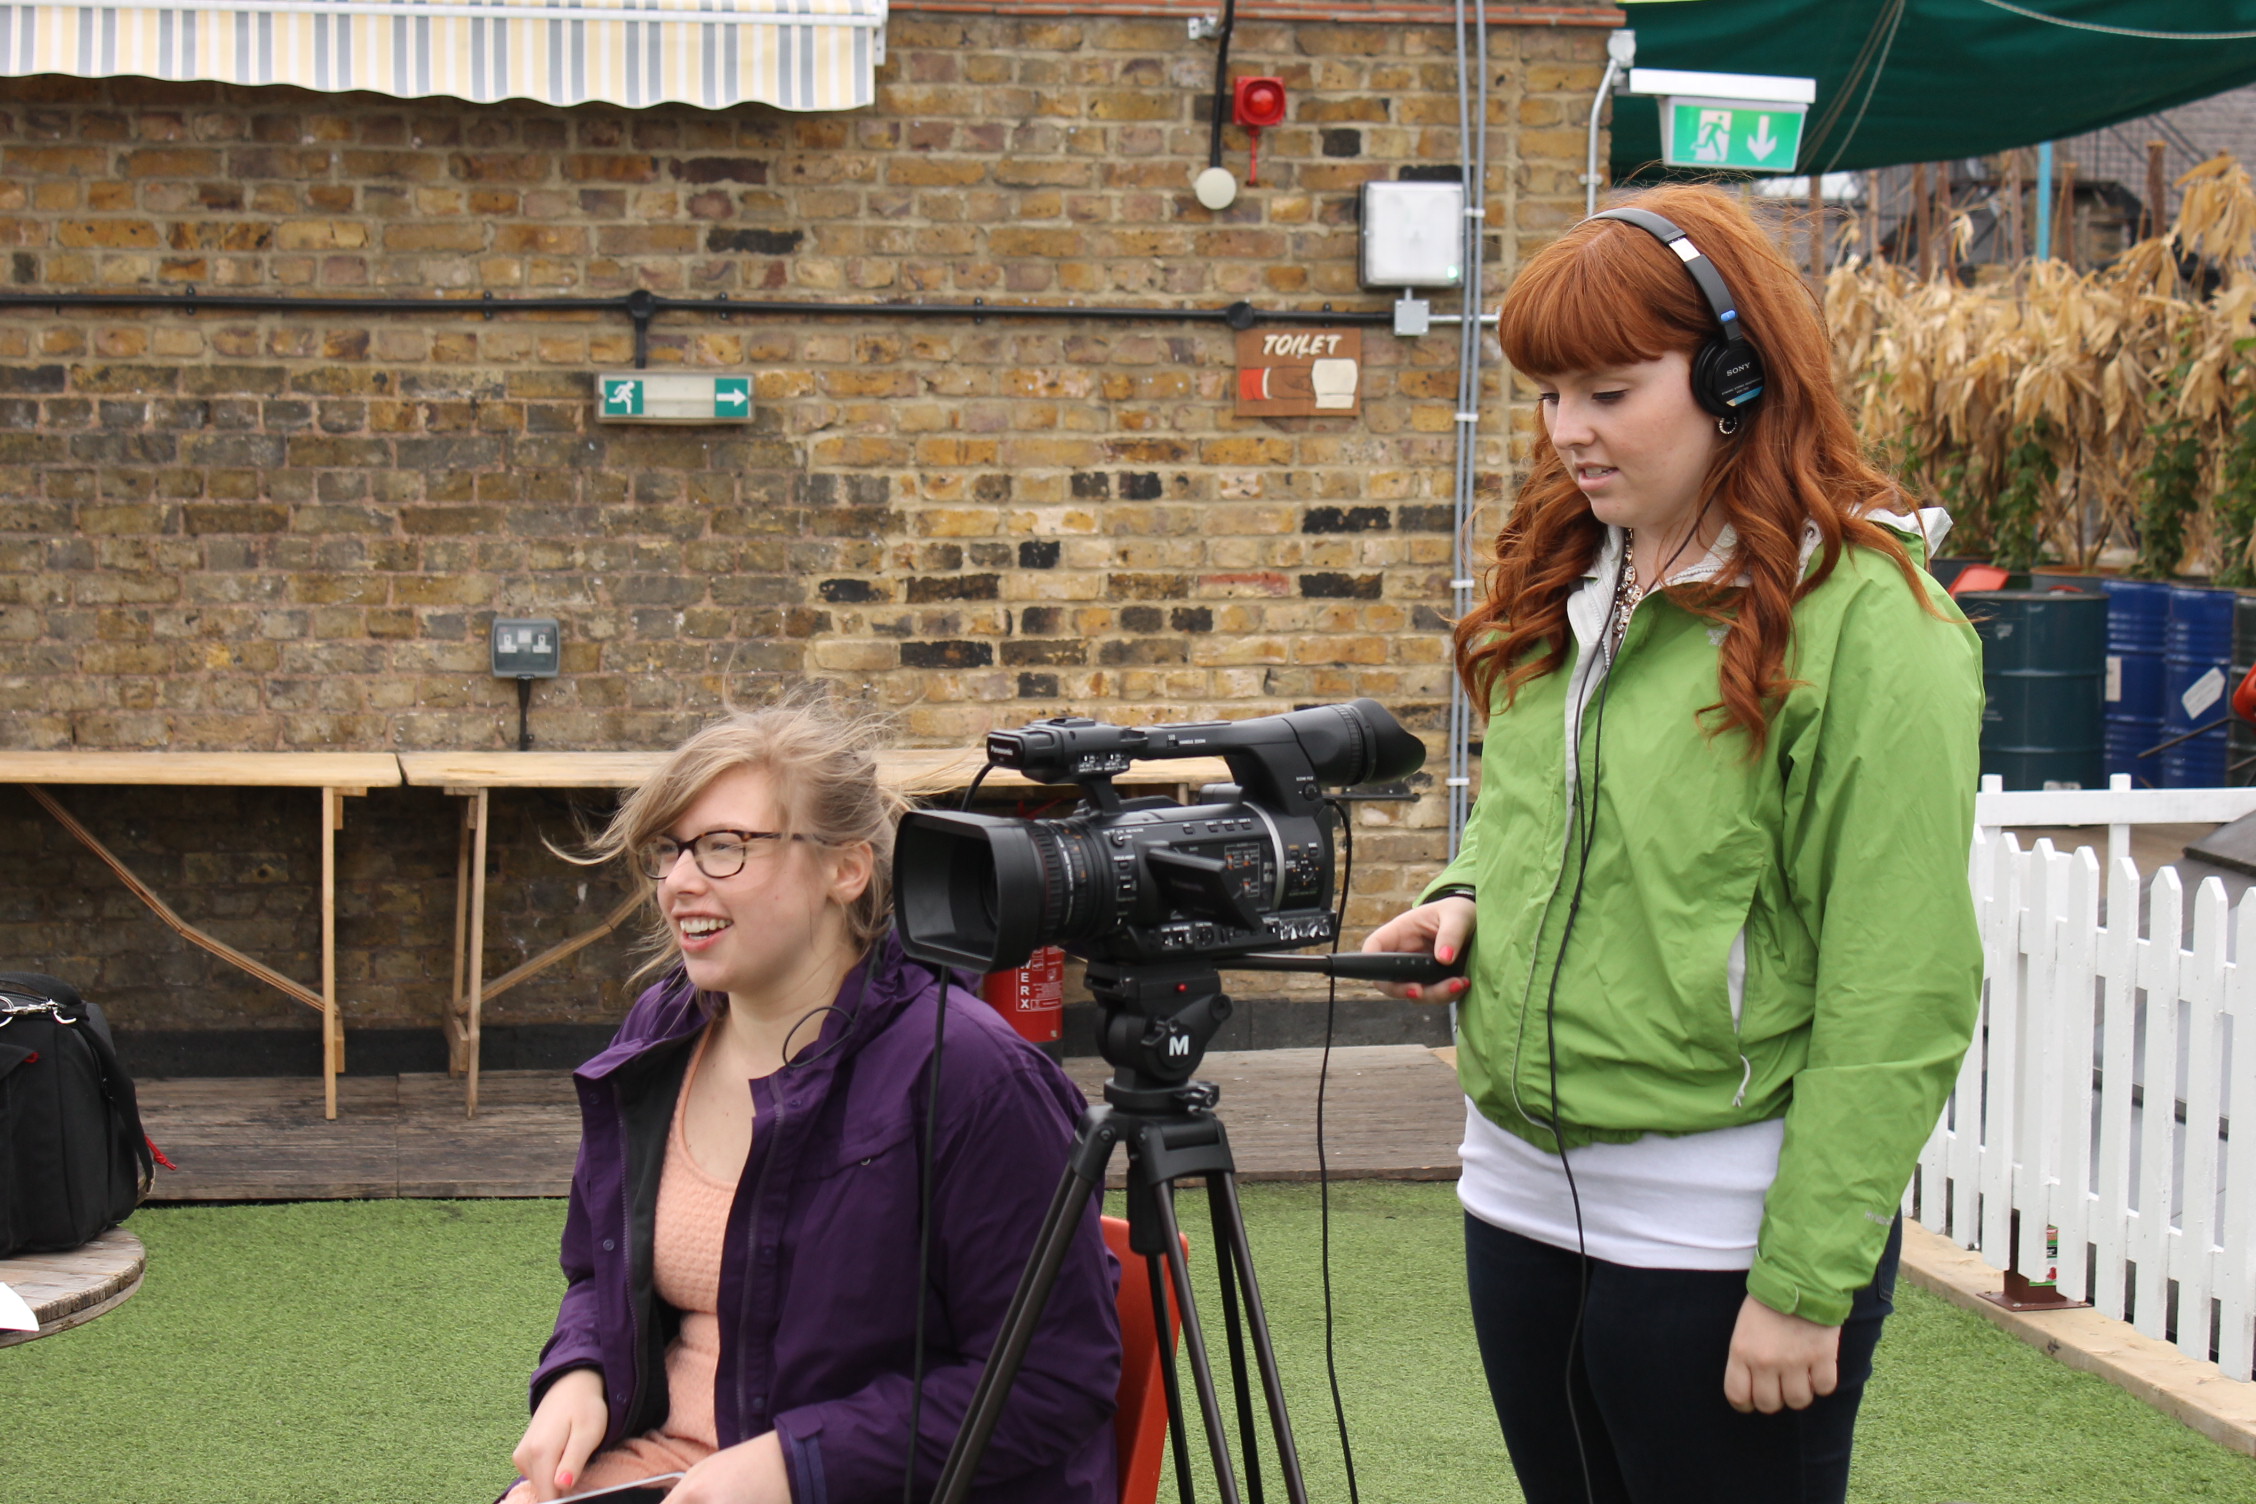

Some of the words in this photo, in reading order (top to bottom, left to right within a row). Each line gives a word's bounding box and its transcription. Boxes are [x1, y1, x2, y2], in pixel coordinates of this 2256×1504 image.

[1263, 334, 1342, 356] TOILET
[1726, 362, 1750, 376] SONY
[1168, 1034, 1189, 1056] M
